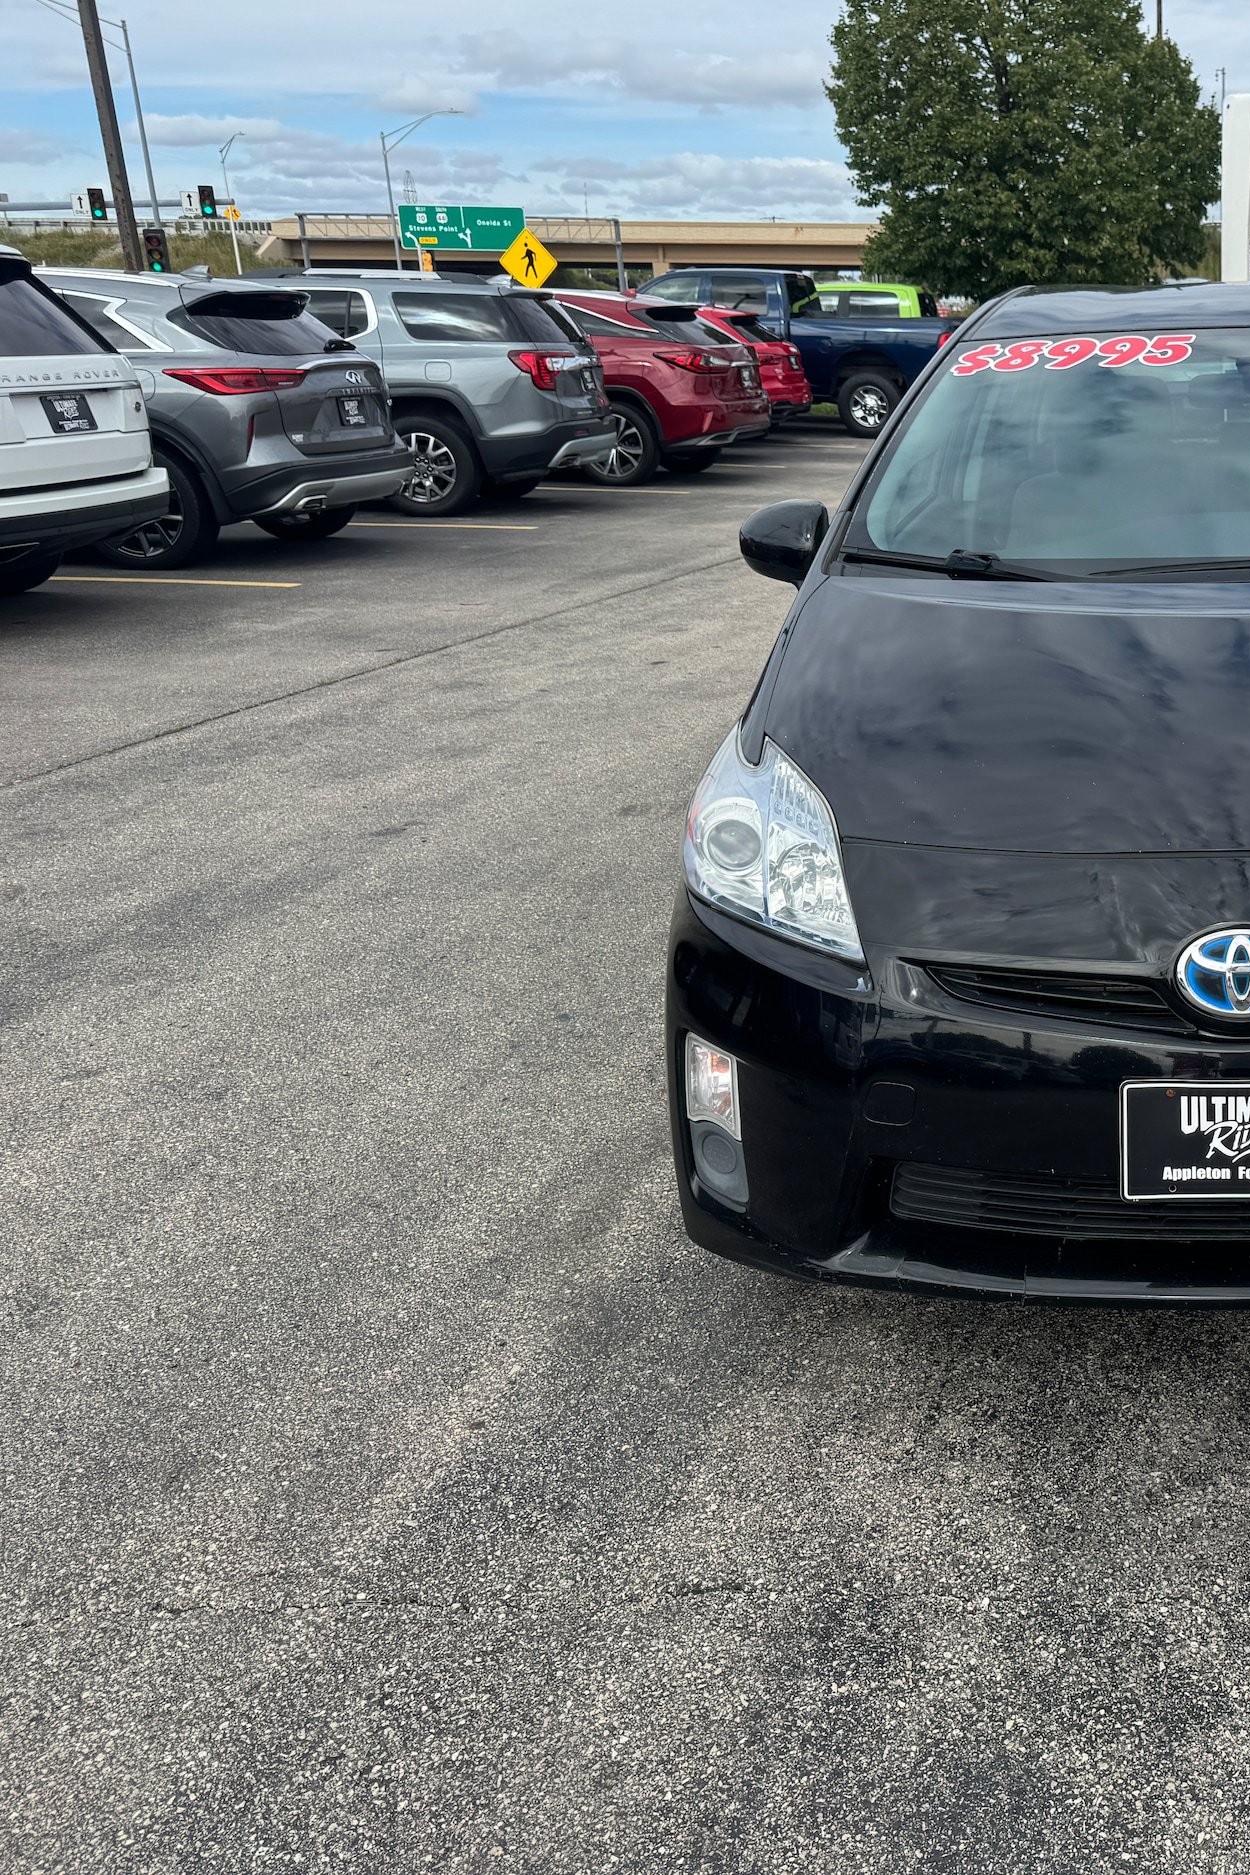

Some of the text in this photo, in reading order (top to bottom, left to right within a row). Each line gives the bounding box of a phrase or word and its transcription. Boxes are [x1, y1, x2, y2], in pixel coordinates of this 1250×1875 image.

[951, 334, 1196, 376] $8995
[2, 370, 120, 382] RANGE ROVER
[1162, 1166, 1231, 1181] Appleton
